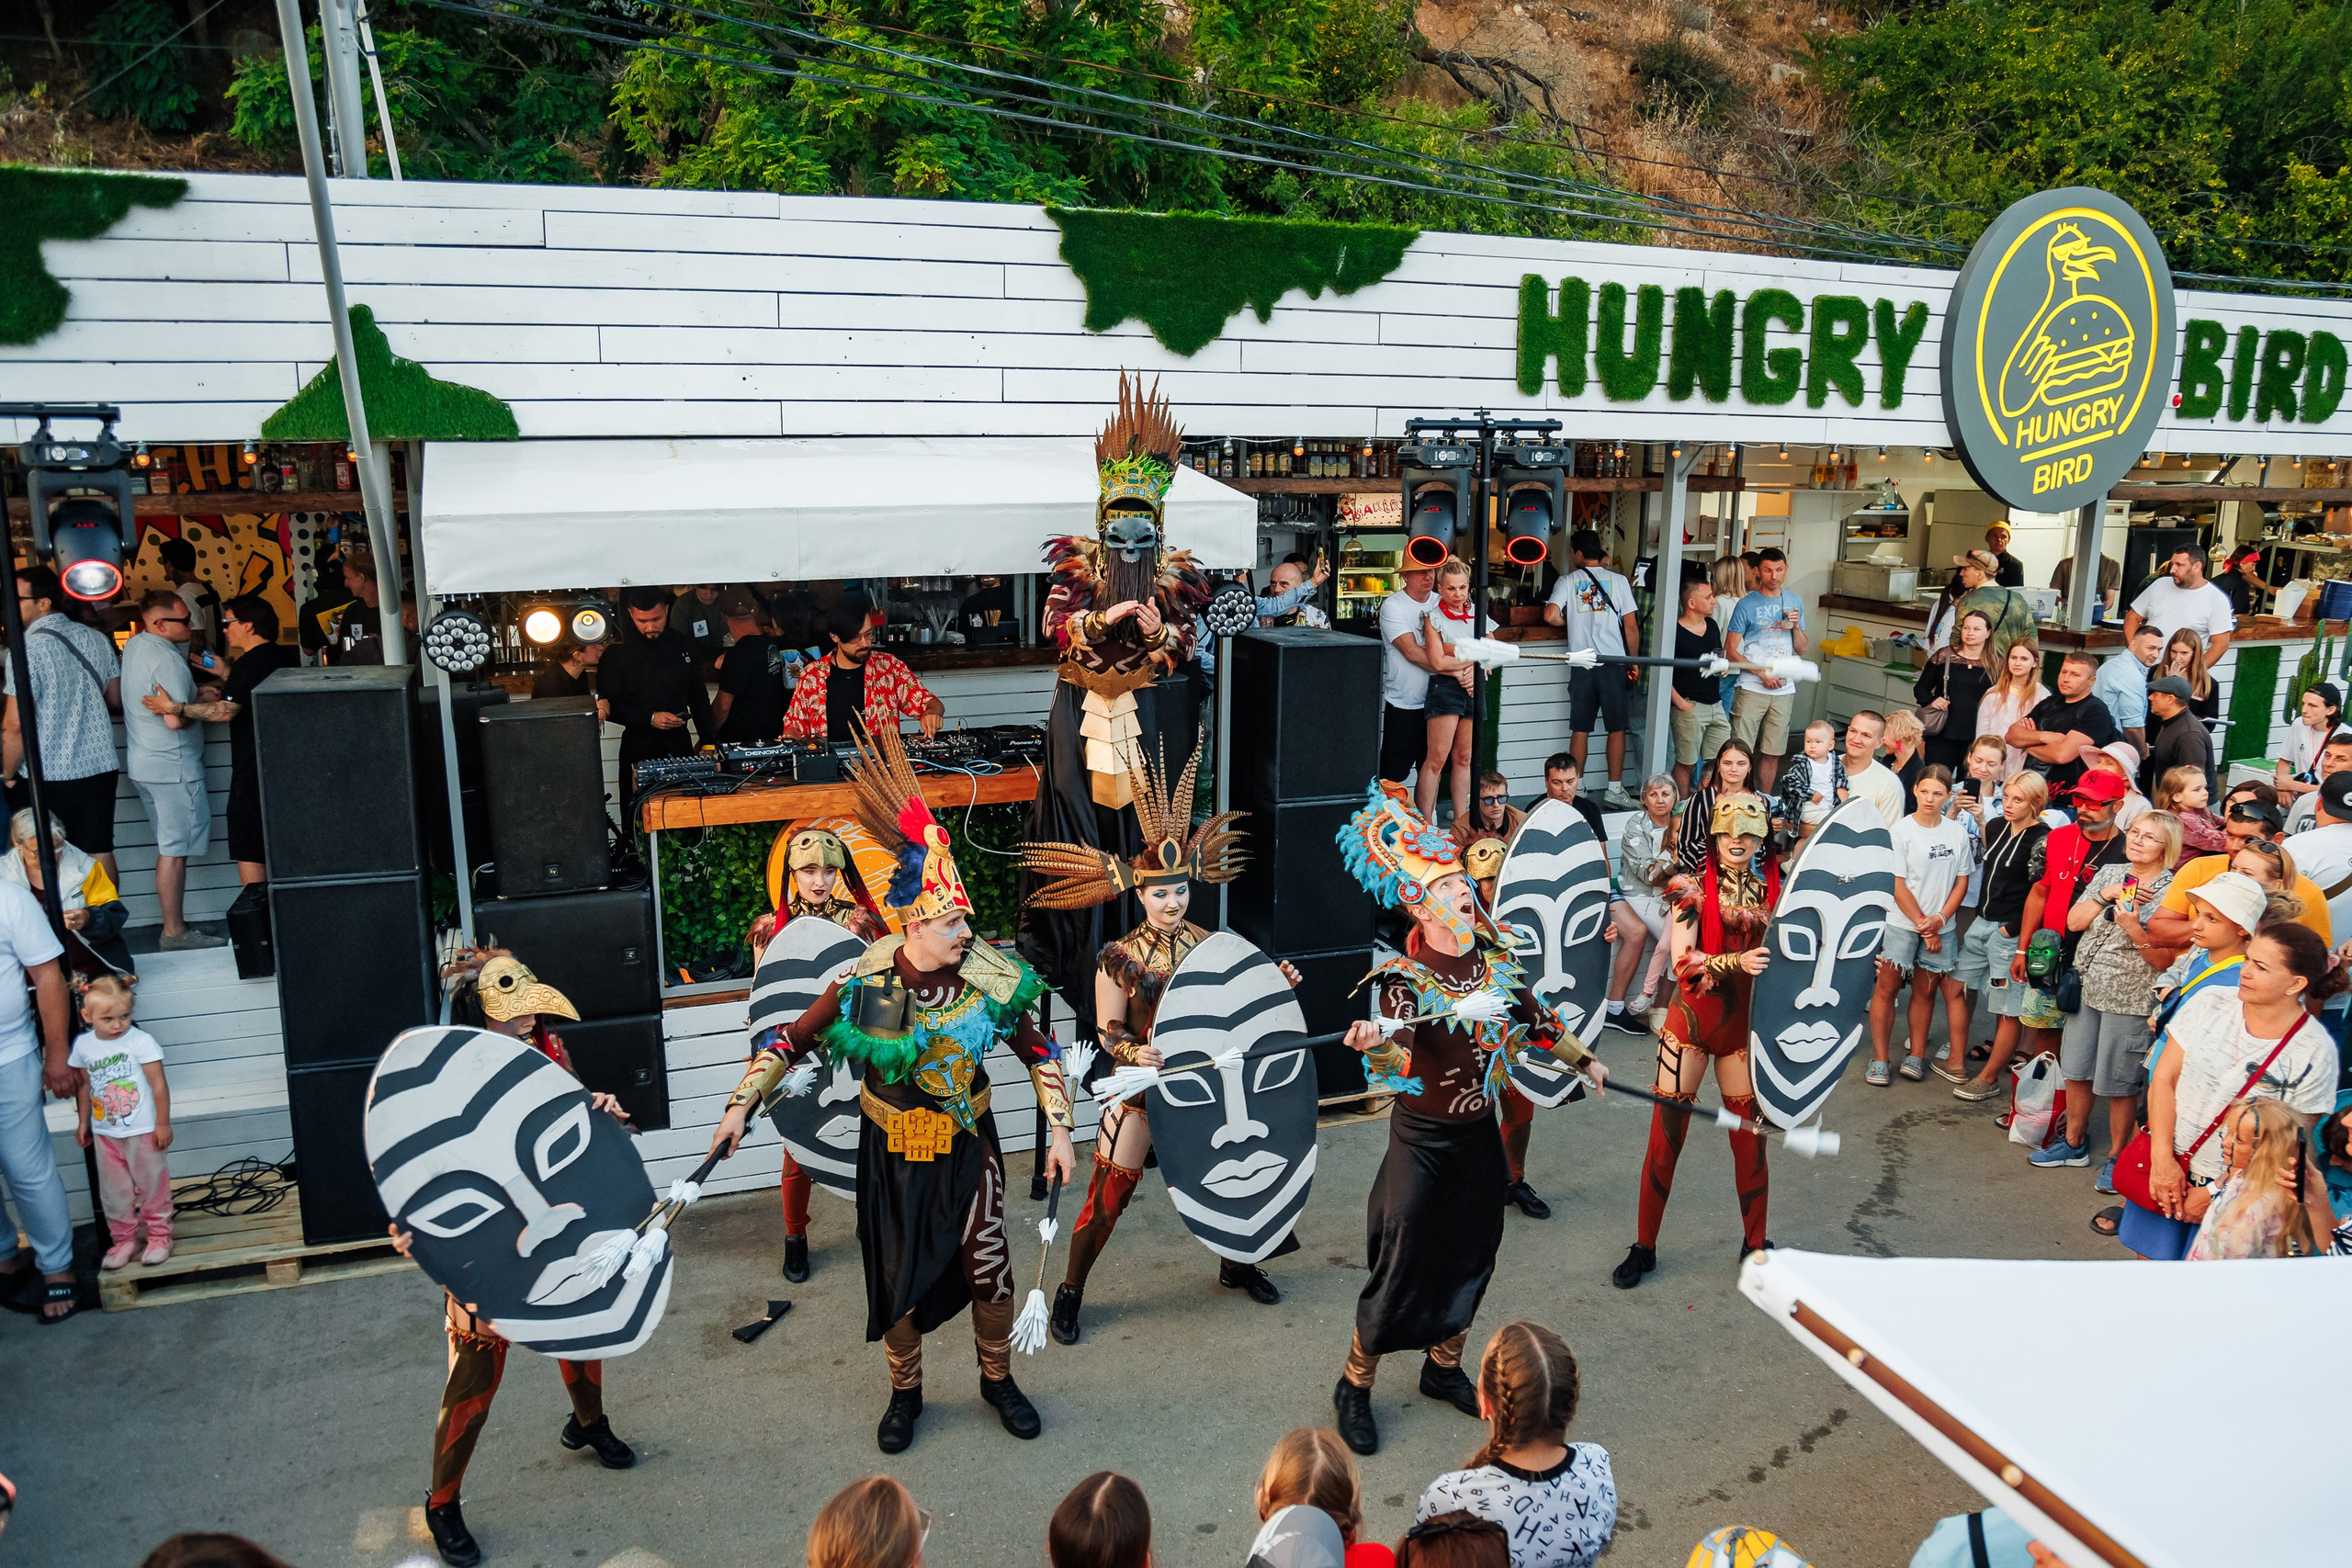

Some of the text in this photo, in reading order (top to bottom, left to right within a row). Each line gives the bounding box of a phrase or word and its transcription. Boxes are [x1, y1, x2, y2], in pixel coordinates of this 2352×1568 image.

[1517, 274, 2348, 423] HUNGRY BIRD
[2015, 393, 2125, 449] HUNGRY
[2032, 453, 2094, 495] BIRD
